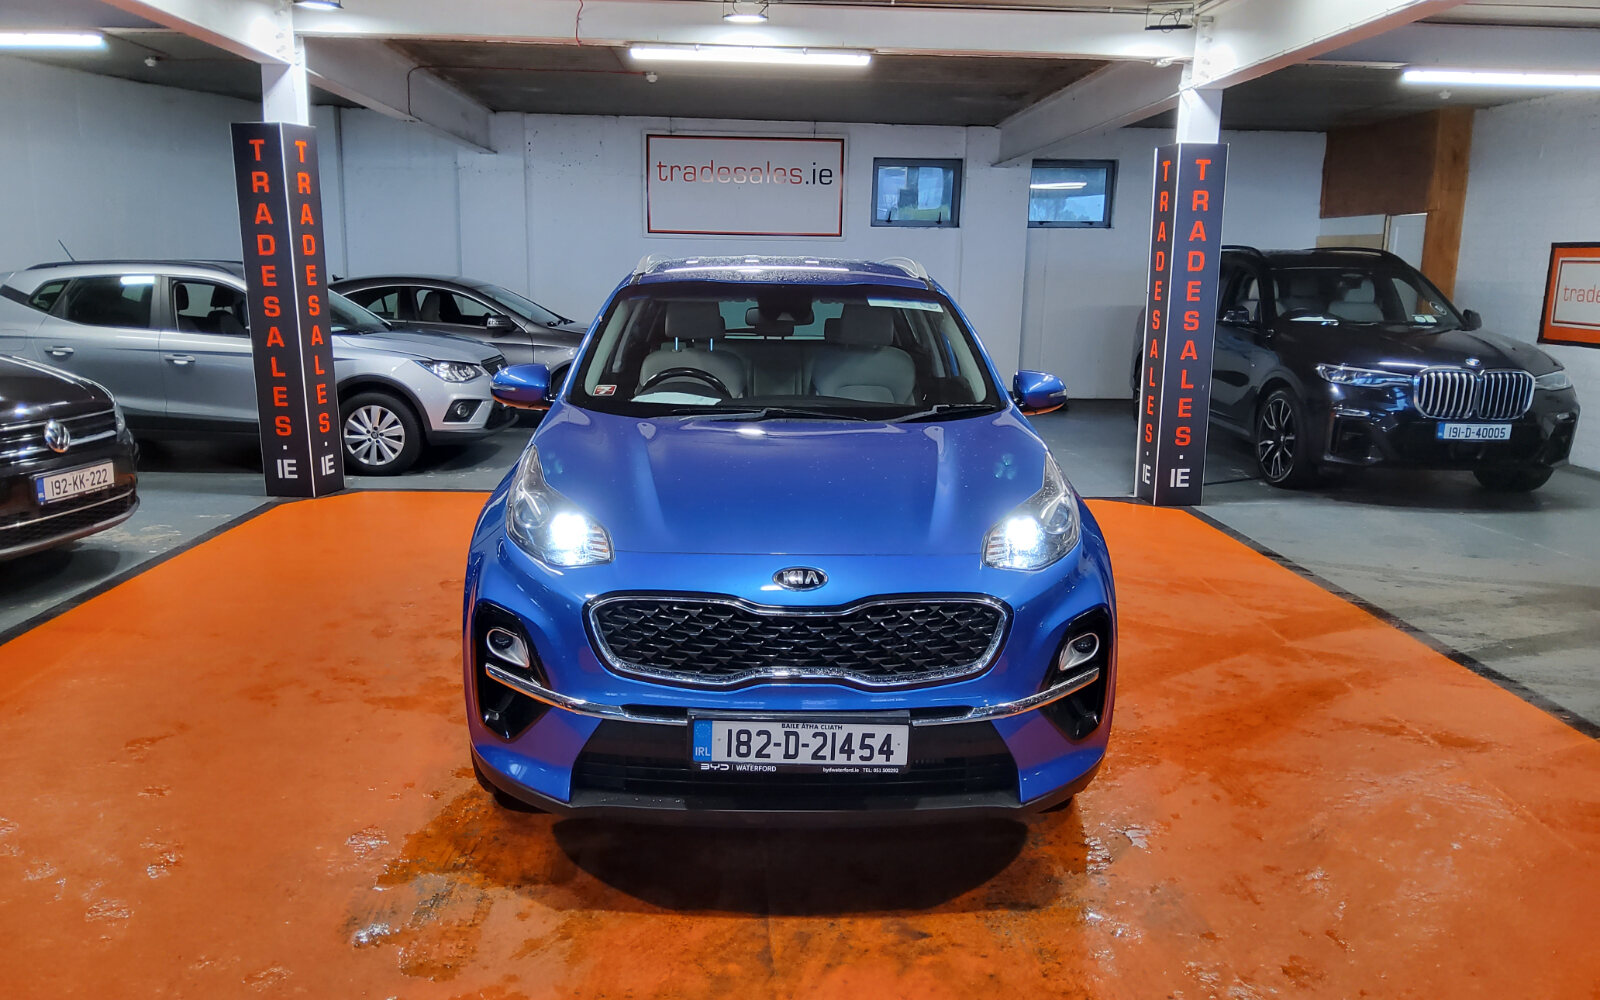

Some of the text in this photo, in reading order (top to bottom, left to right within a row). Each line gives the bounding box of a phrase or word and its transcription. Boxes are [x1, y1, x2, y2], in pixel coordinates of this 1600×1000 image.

[656, 160, 833, 185] tradesales.ie
[1448, 426, 1507, 439] 191-D-40005
[50, 468, 108, 497] 192-KK-222
[782, 570, 820, 585] KIA
[695, 746, 711, 757] IRL
[726, 728, 894, 763] 182-D-21454
[736, 764, 777, 772] WATERFORD
